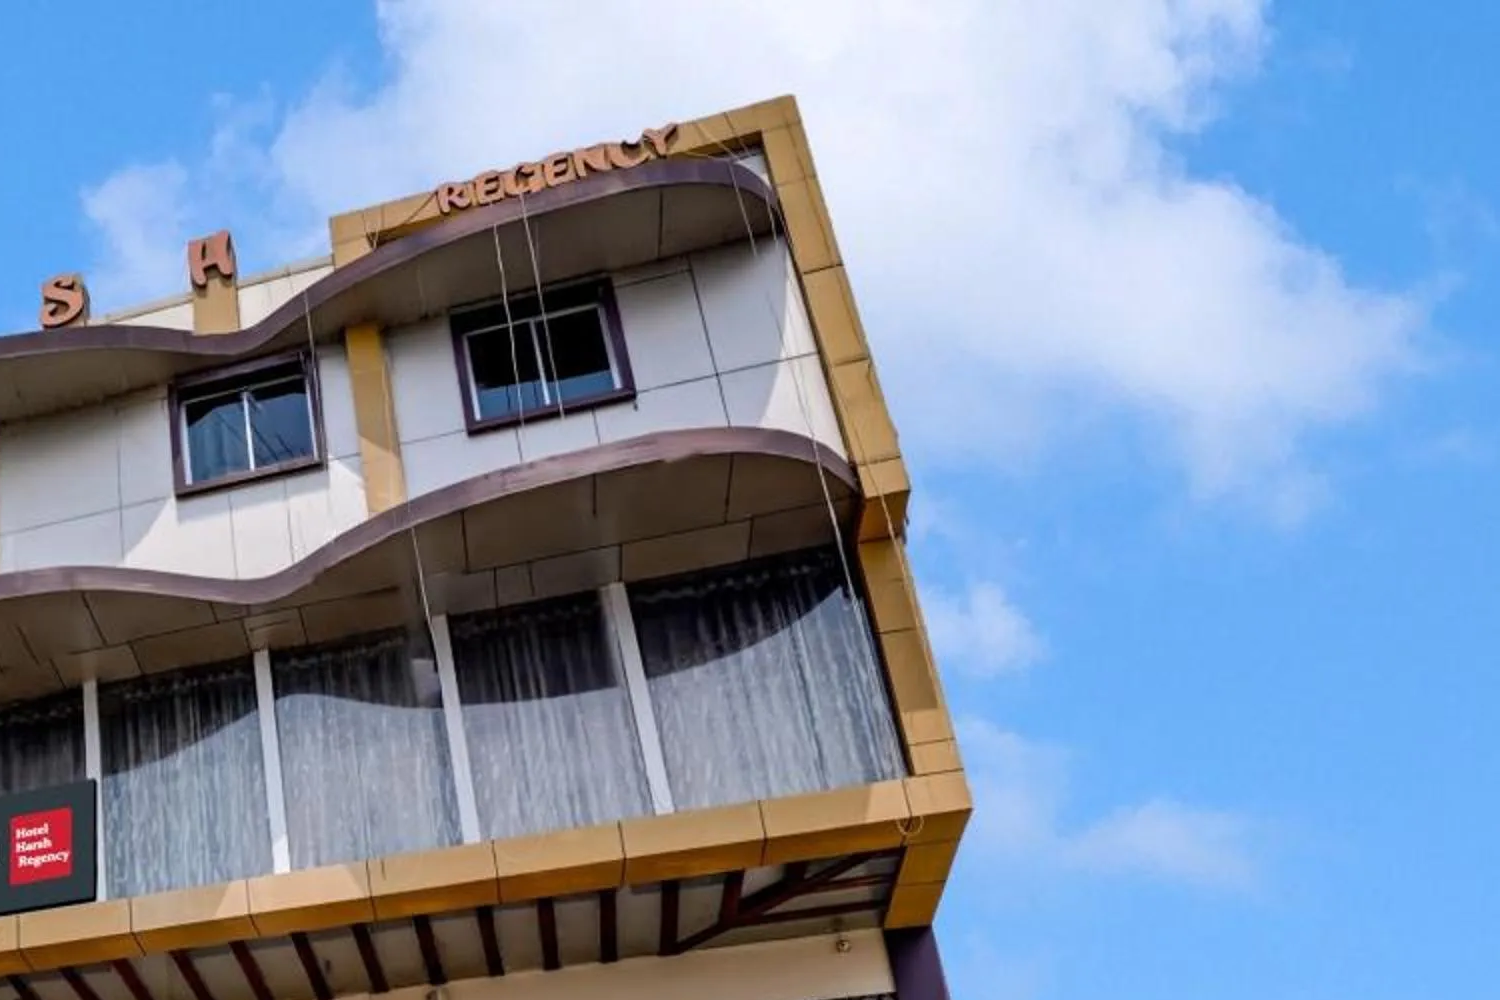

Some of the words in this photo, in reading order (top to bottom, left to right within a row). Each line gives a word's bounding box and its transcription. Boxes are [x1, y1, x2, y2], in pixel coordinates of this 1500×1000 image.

[435, 122, 678, 216] REGENCY
[16, 822, 49, 839] Hotel
[16, 837, 52, 853] Harsh
[18, 850, 69, 868] Regency
